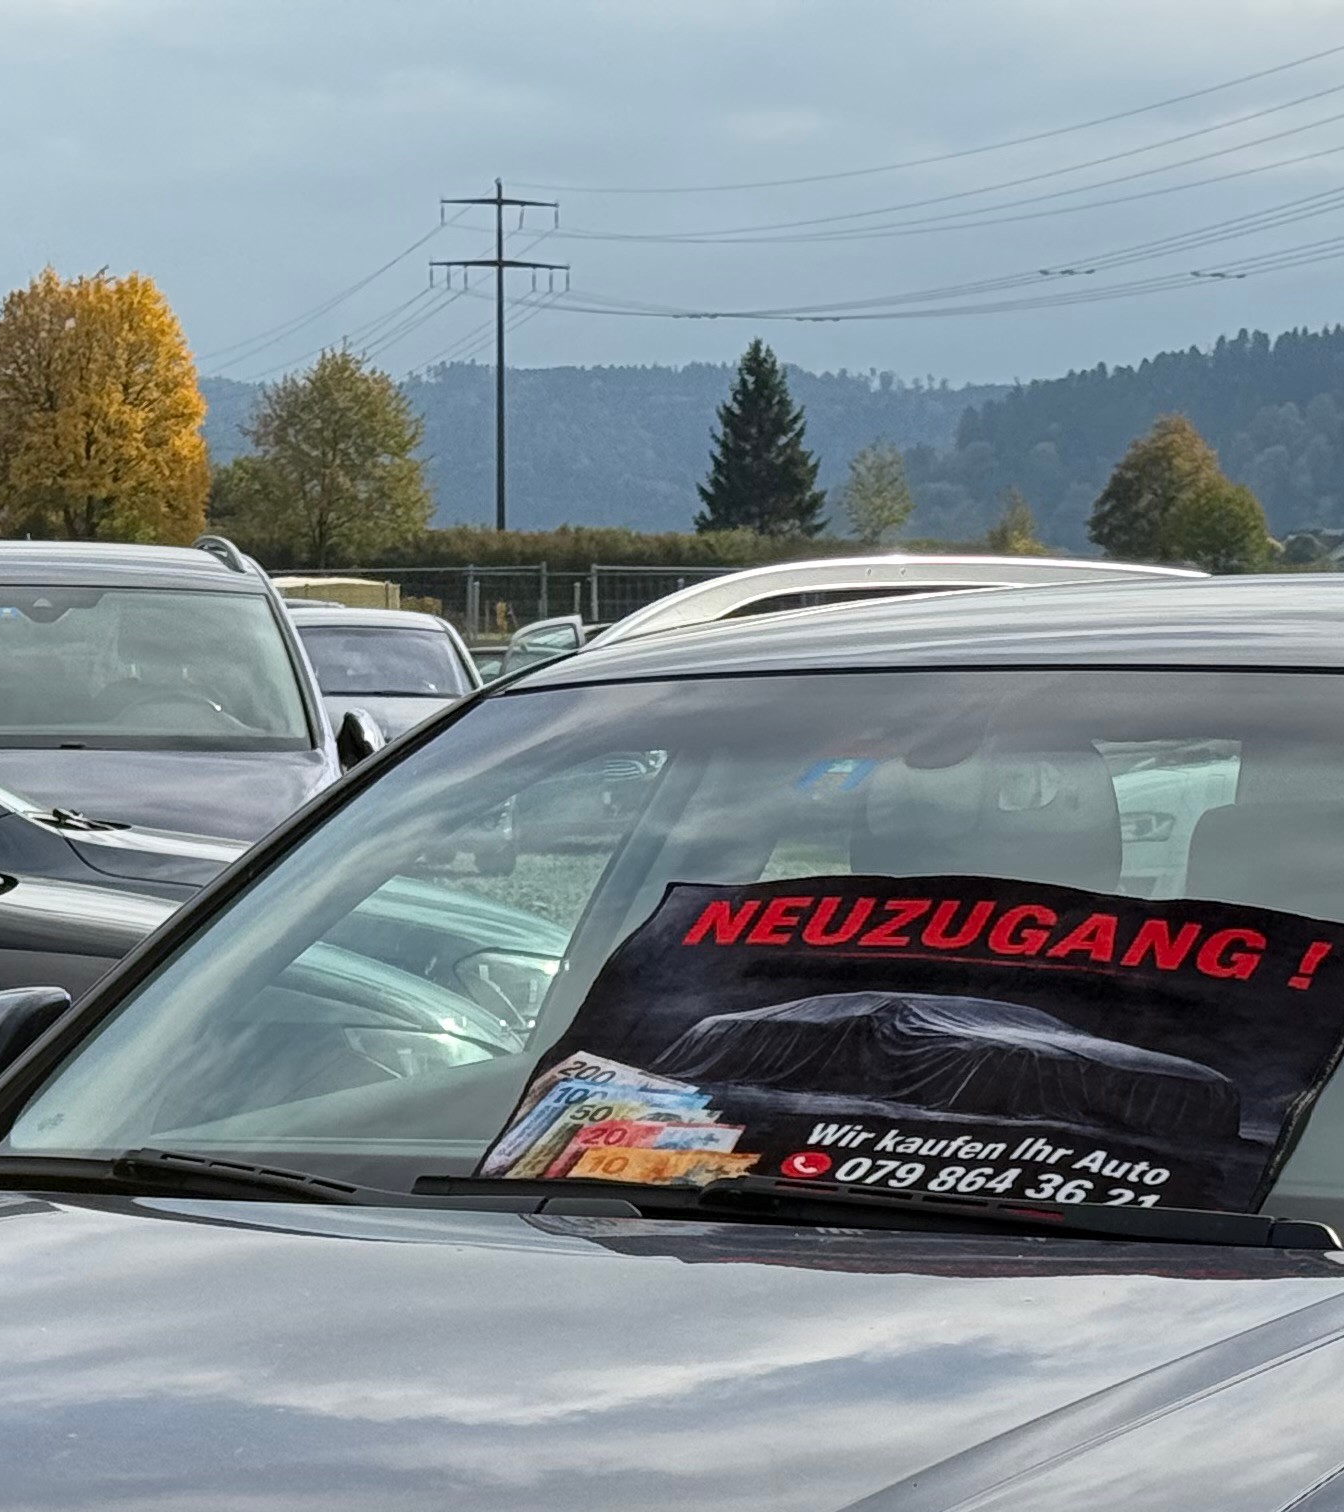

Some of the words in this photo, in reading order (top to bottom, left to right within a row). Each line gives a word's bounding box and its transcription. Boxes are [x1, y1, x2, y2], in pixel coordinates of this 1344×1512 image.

[682, 896, 1267, 981] NEUZUGANG
[558, 1061, 616, 1086] 200
[570, 1104, 613, 1122] 50
[581, 1127, 628, 1146] 20
[588, 1156, 630, 1175] 10
[807, 1123, 876, 1148] Wir
[873, 1129, 1007, 1161] kaufen
[1009, 1137, 1074, 1164] Ihr
[1071, 1150, 1171, 1186] Auto
[835, 1157, 926, 1188] 079
[927, 1166, 1022, 1193] 864
[1024, 1173, 1095, 1204] 36
